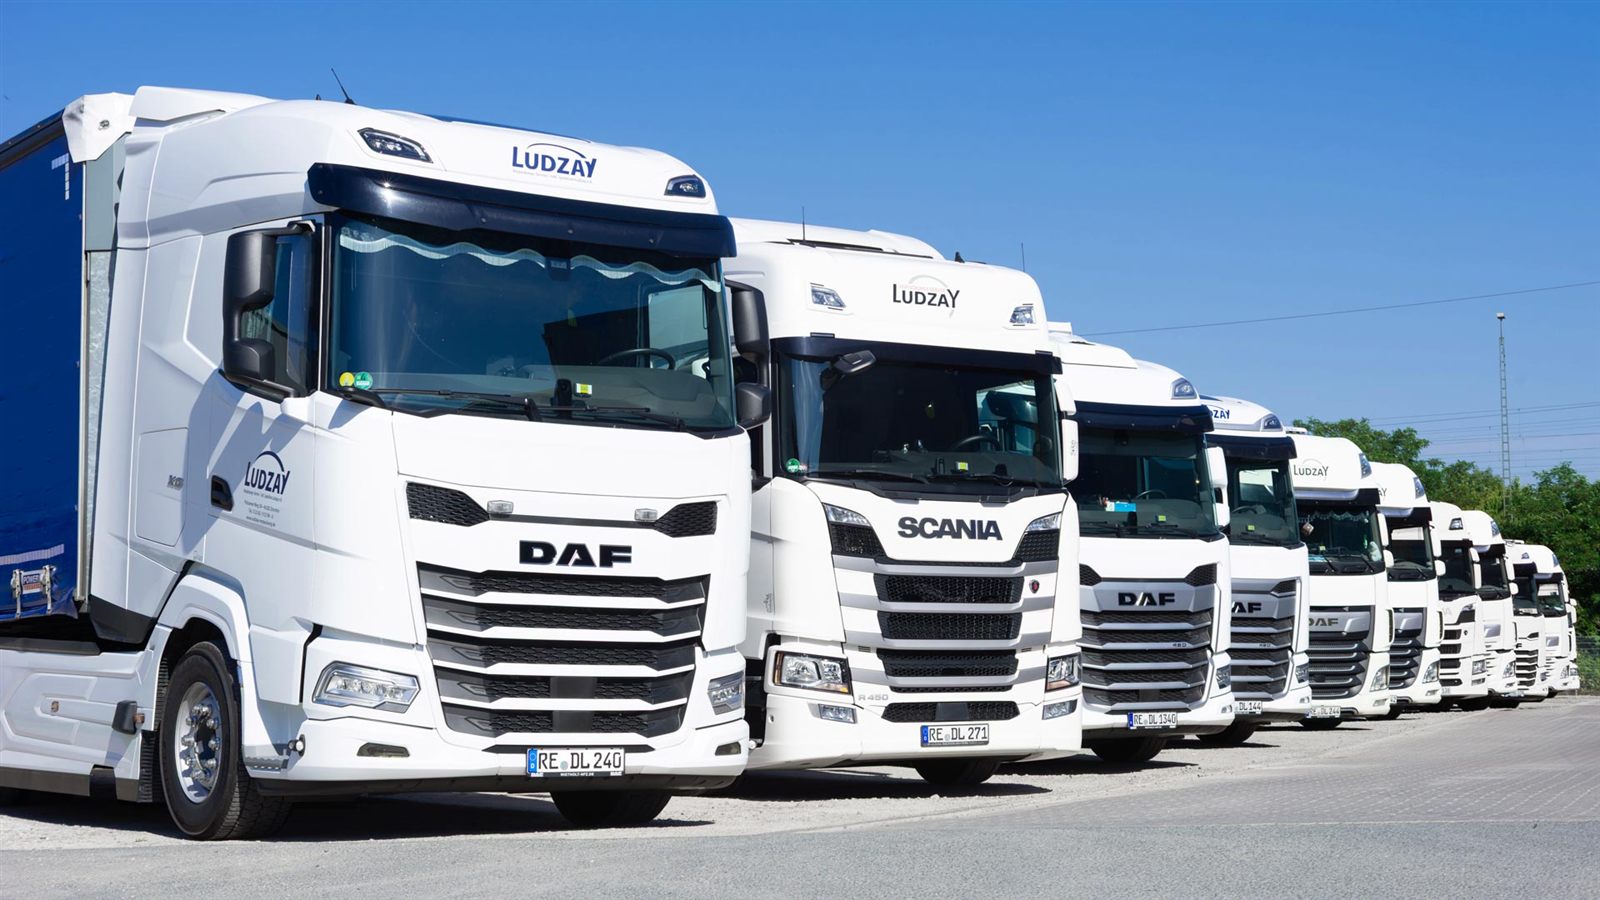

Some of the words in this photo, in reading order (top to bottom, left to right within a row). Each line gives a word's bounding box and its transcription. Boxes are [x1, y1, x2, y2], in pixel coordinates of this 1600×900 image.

[512, 146, 597, 178] LUDZAY
[893, 283, 960, 308] LUDZAY
[1210, 409, 1230, 419] ZAY
[244, 461, 290, 495] LUDZAY
[1293, 465, 1329, 477] LUDZAY
[897, 516, 1003, 541] SCANIA
[519, 540, 632, 568] DAF
[1118, 592, 1175, 606] DAF
[1231, 602, 1262, 613] AF
[1240, 702, 1248, 711] DL
[1248, 702, 1261, 711] 144
[1133, 715, 1143, 725] RE
[1148, 715, 1158, 725] DL
[1159, 714, 1176, 724] 1340
[929, 728, 943, 741] RE
[951, 728, 965, 740] DL
[968, 727, 987, 740] 271
[538, 752, 559, 770] RE
[570, 752, 590, 769] DL
[593, 752, 622, 769] 240
